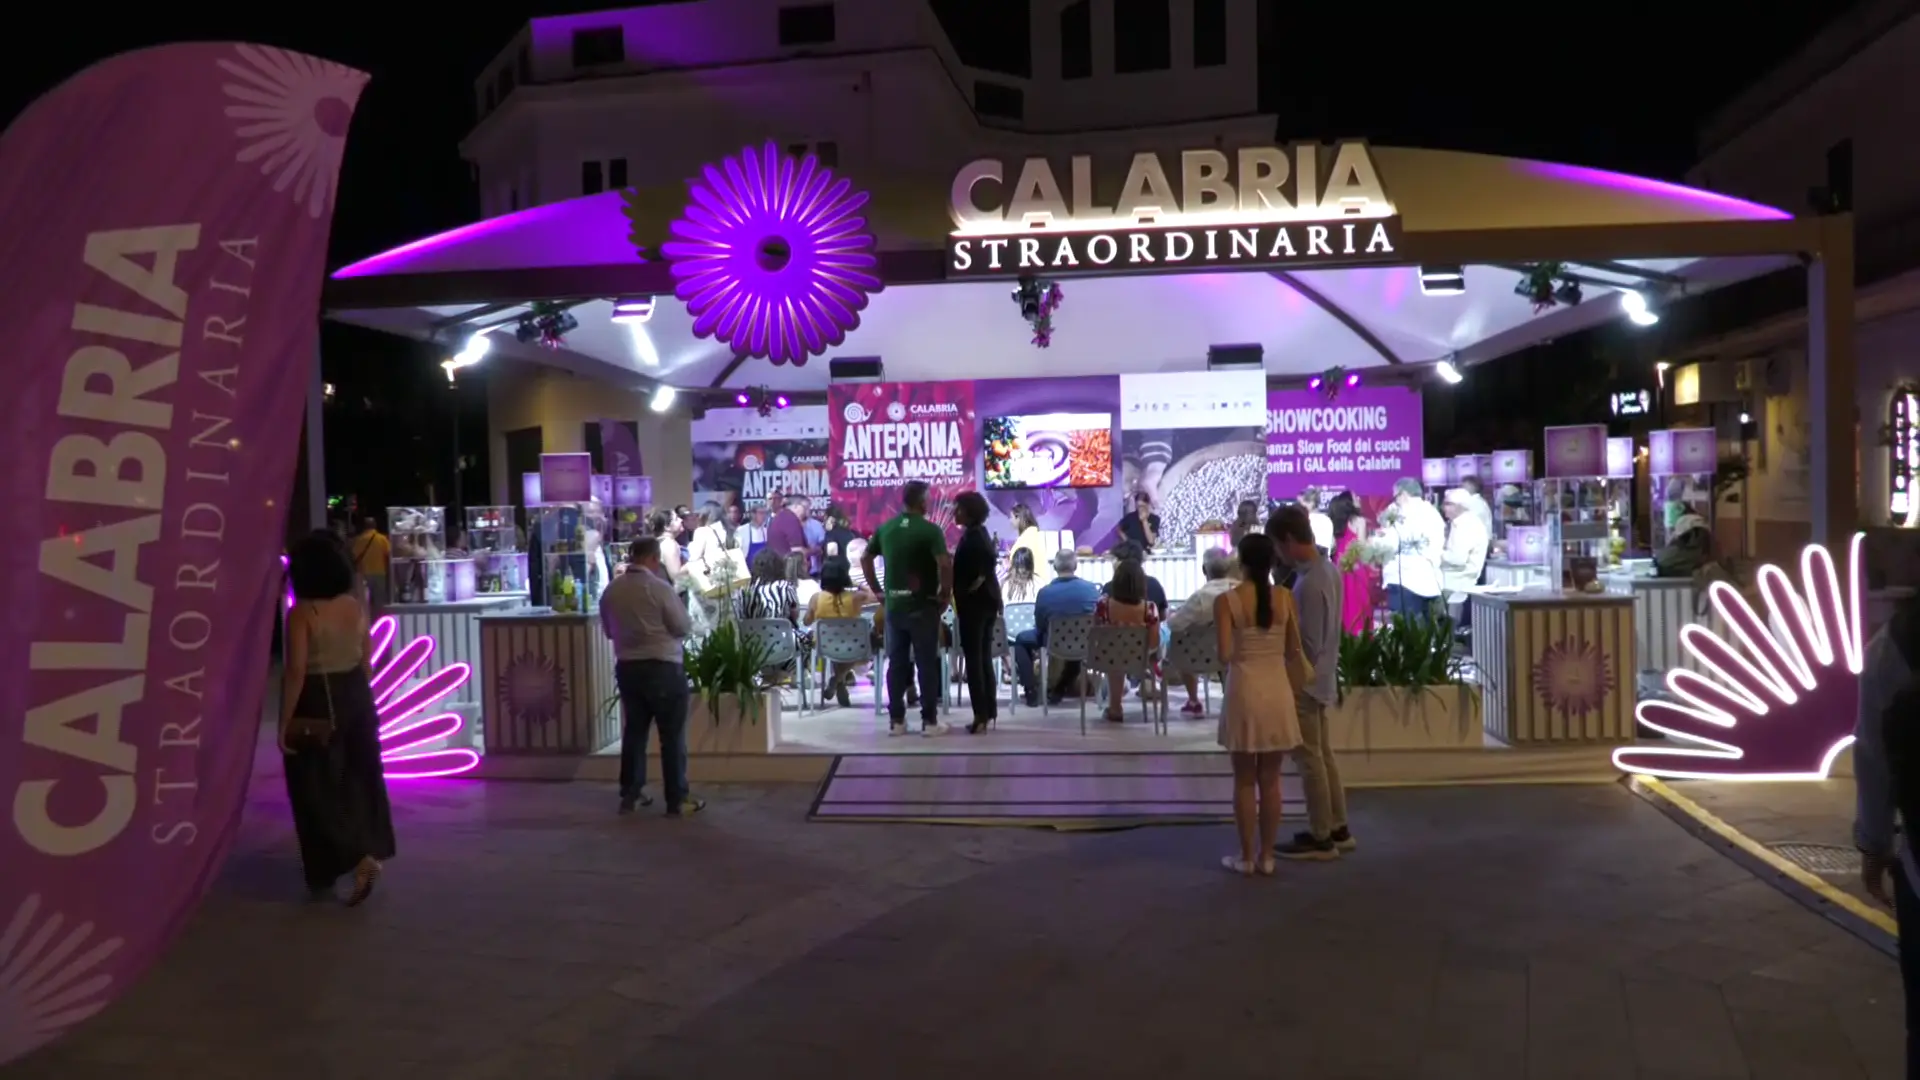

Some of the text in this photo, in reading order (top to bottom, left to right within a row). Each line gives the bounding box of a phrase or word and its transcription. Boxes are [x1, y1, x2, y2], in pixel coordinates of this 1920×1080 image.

[951, 142, 1394, 232] CALABRIA
[953, 222, 1395, 271] STRAORDINARIA
[910, 404, 958, 413] CALABRIA
[1266, 406, 1388, 434] SHOWCOOKING
[843, 421, 963, 460] ANTEPRIMA
[1297, 439, 1324, 455] Slow
[1327, 438, 1352, 454] Food
[1374, 436, 1410, 452] cuochi
[843, 458, 964, 478] TERRA MADRE
[1303, 456, 1326, 473] GAL
[1327, 456, 1354, 472] della
[1357, 454, 1402, 471] Calabria
[743, 469, 831, 498] ANTEPRIMA
[843, 480, 868, 488] 19-21
[869, 478, 904, 487] GIUGNO
[13, 222, 201, 857] CALABRIA
[152, 235, 258, 846] STRAORDINARIA
